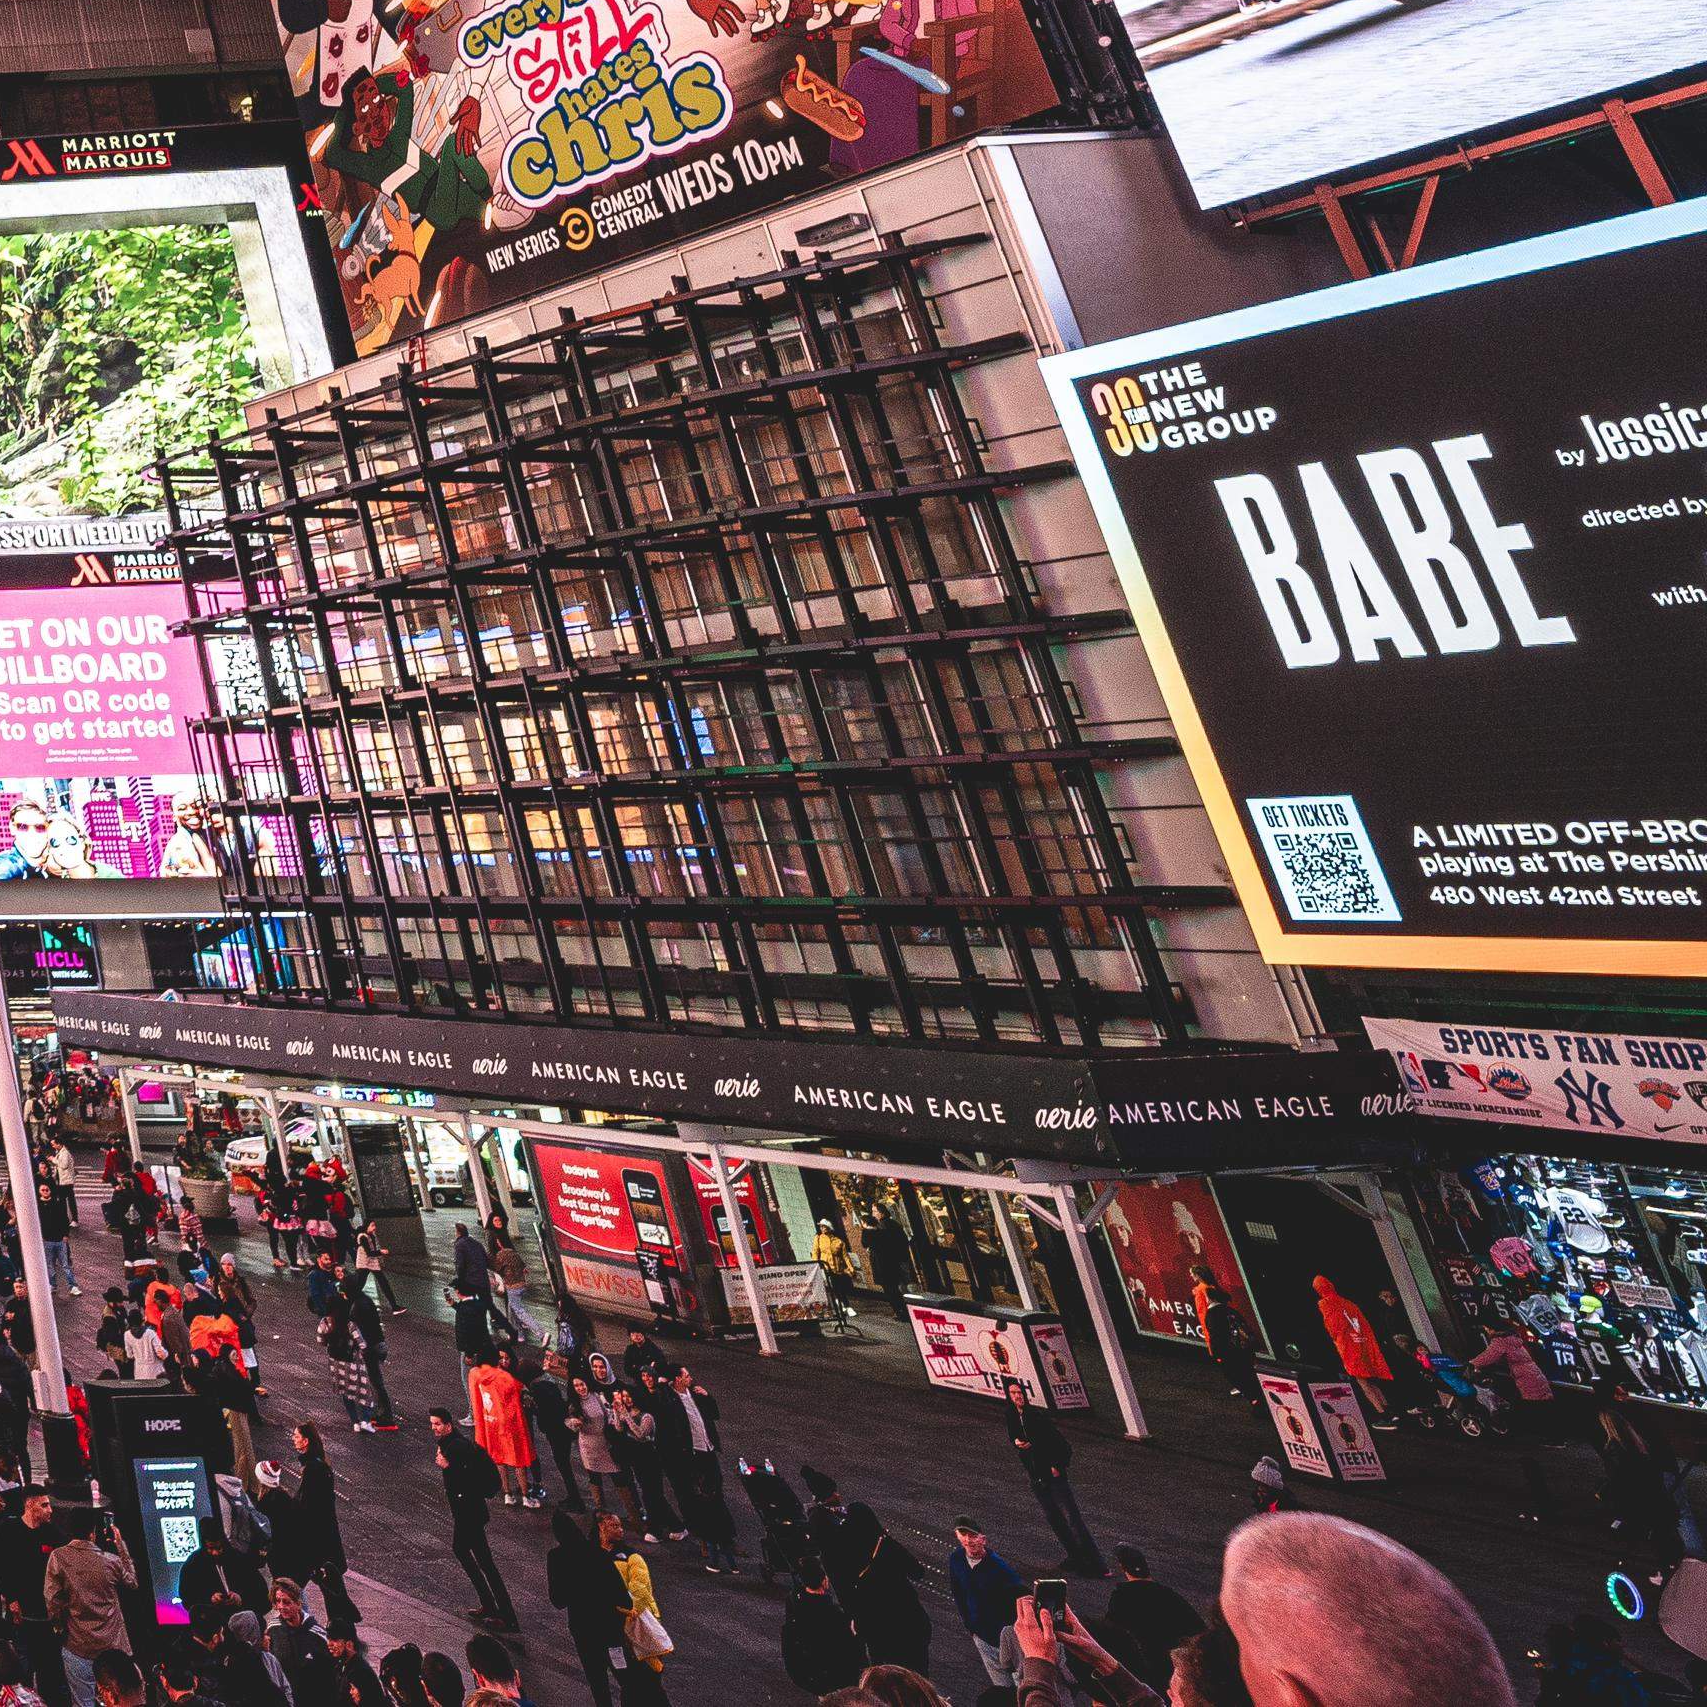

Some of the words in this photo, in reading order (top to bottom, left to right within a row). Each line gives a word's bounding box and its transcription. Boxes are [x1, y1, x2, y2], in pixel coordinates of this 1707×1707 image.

[555, 38, 654, 121] hates
[61, 132, 177, 152] MARRIOTT
[508, 62, 726, 201] chris
[65, 150, 169, 170] MARQUIS
[656, 153, 734, 215] WEDS
[591, 181, 653, 219] COMEDY
[597, 201, 663, 239] CENTRAL
[486, 243, 513, 273] NEW
[516, 227, 560, 265] SERIES
[1140, 363, 1207, 395] THE
[1150, 389, 1226, 421] NEW
[1160, 407, 1278, 449] GROUP
[1557, 443, 1585, 471] by
[1583, 500, 1674, 528] directed
[73, 521, 141, 547] NEEDED
[1214, 433, 1577, 670] BABE
[1652, 586, 1706, 606] with
[39, 617, 91, 647] ON
[96, 615, 170, 645] OUR
[62, 689, 101, 714] QR
[108, 688, 171, 712] code
[32, 718, 77, 745] get
[81, 714, 176, 739] started
[1262, 805, 1287, 831] GET
[1289, 801, 1349, 829] TICKETS
[1412, 826, 1435, 847] A
[1438, 822, 1558, 849] LIMITED
[1420, 852, 1513, 877] playing
[1519, 855, 1544, 873] at
[1550, 851, 1586, 872] The
[1430, 885, 1473, 904] 480
[1479, 885, 1539, 904] West
[1548, 884, 1608, 904] 42nd
[1615, 884, 1702, 904] Street
[1439, 1028, 1549, 1061] SPORTS
[1556, 1035, 1621, 1066] FAN
[101, 1019, 131, 1036] EAGLE
[175, 1029, 230, 1046] AMERICAN
[234, 1034, 271, 1050] EAGLE
[332, 1044, 402, 1065] AMERICAN
[409, 1051, 452, 1070] EAGLE
[472, 1053, 507, 1076] aerie
[532, 1061, 623, 1085] AMERICAN
[630, 1069, 688, 1091] EAGLE
[715, 1072, 761, 1099] aerie
[794, 1085, 915, 1118] AMERICAN
[928, 1095, 1010, 1125] EAGLE
[1035, 1104, 1097, 1132] aerie
[1109, 1099, 1244, 1125] AMERICAN
[1255, 1094, 1335, 1120] EAGLE
[1361, 1083, 1414, 1119] aerie
[1427, 1099, 1471, 1114] LICENSED
[1472, 1103, 1542, 1118] MERCHANDISE
[562, 1182, 610, 1202] Broadway's
[1558, 1205, 1588, 1224] 22
[145, 1419, 182, 1432] HOPE
[1284, 1440, 1324, 1462] TEETH
[1336, 1450, 1377, 1466] TEETH
